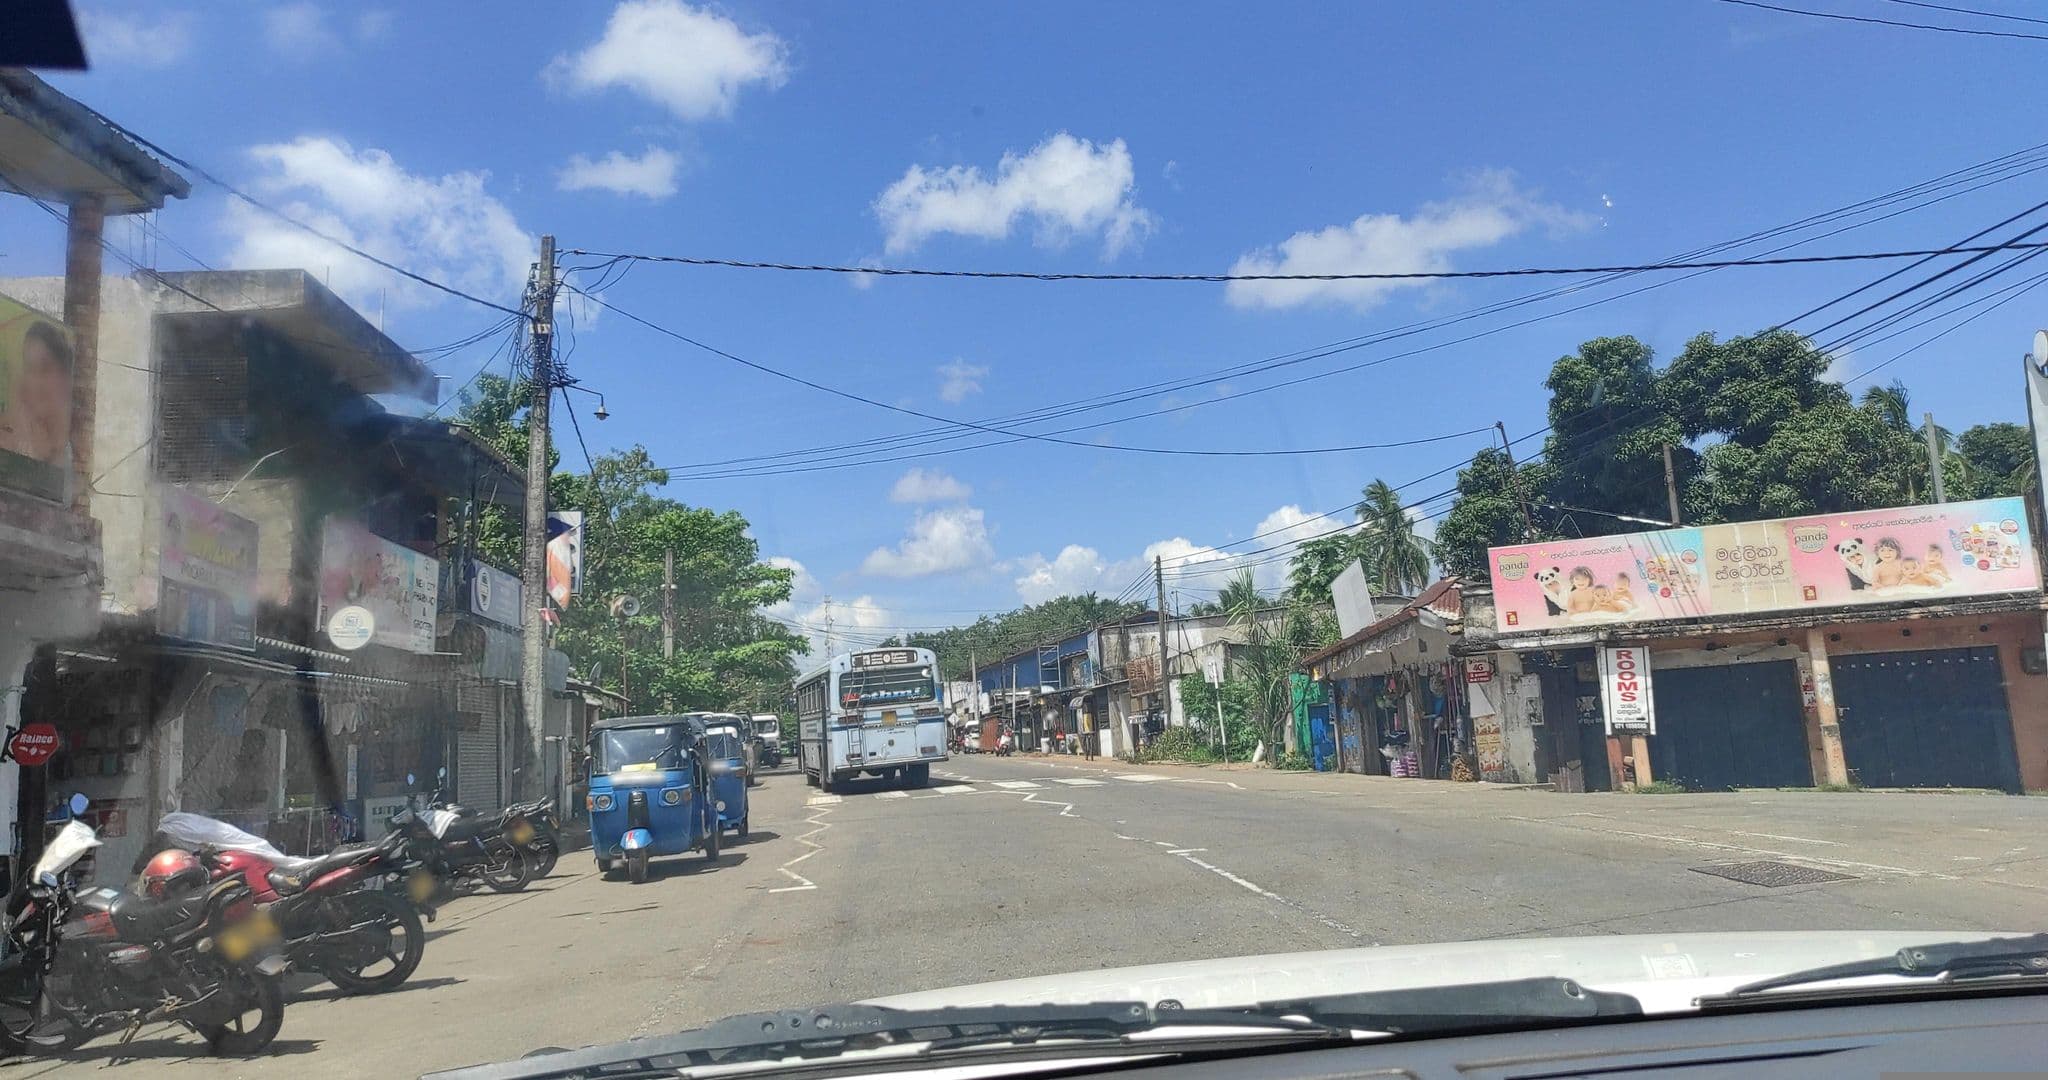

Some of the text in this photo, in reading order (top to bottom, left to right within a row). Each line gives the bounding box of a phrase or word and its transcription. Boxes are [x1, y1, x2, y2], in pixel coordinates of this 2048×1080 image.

[1794, 531, 1828, 544] panda
[1499, 560, 1529, 572] panda
[1616, 650, 1638, 702] ROOMS
